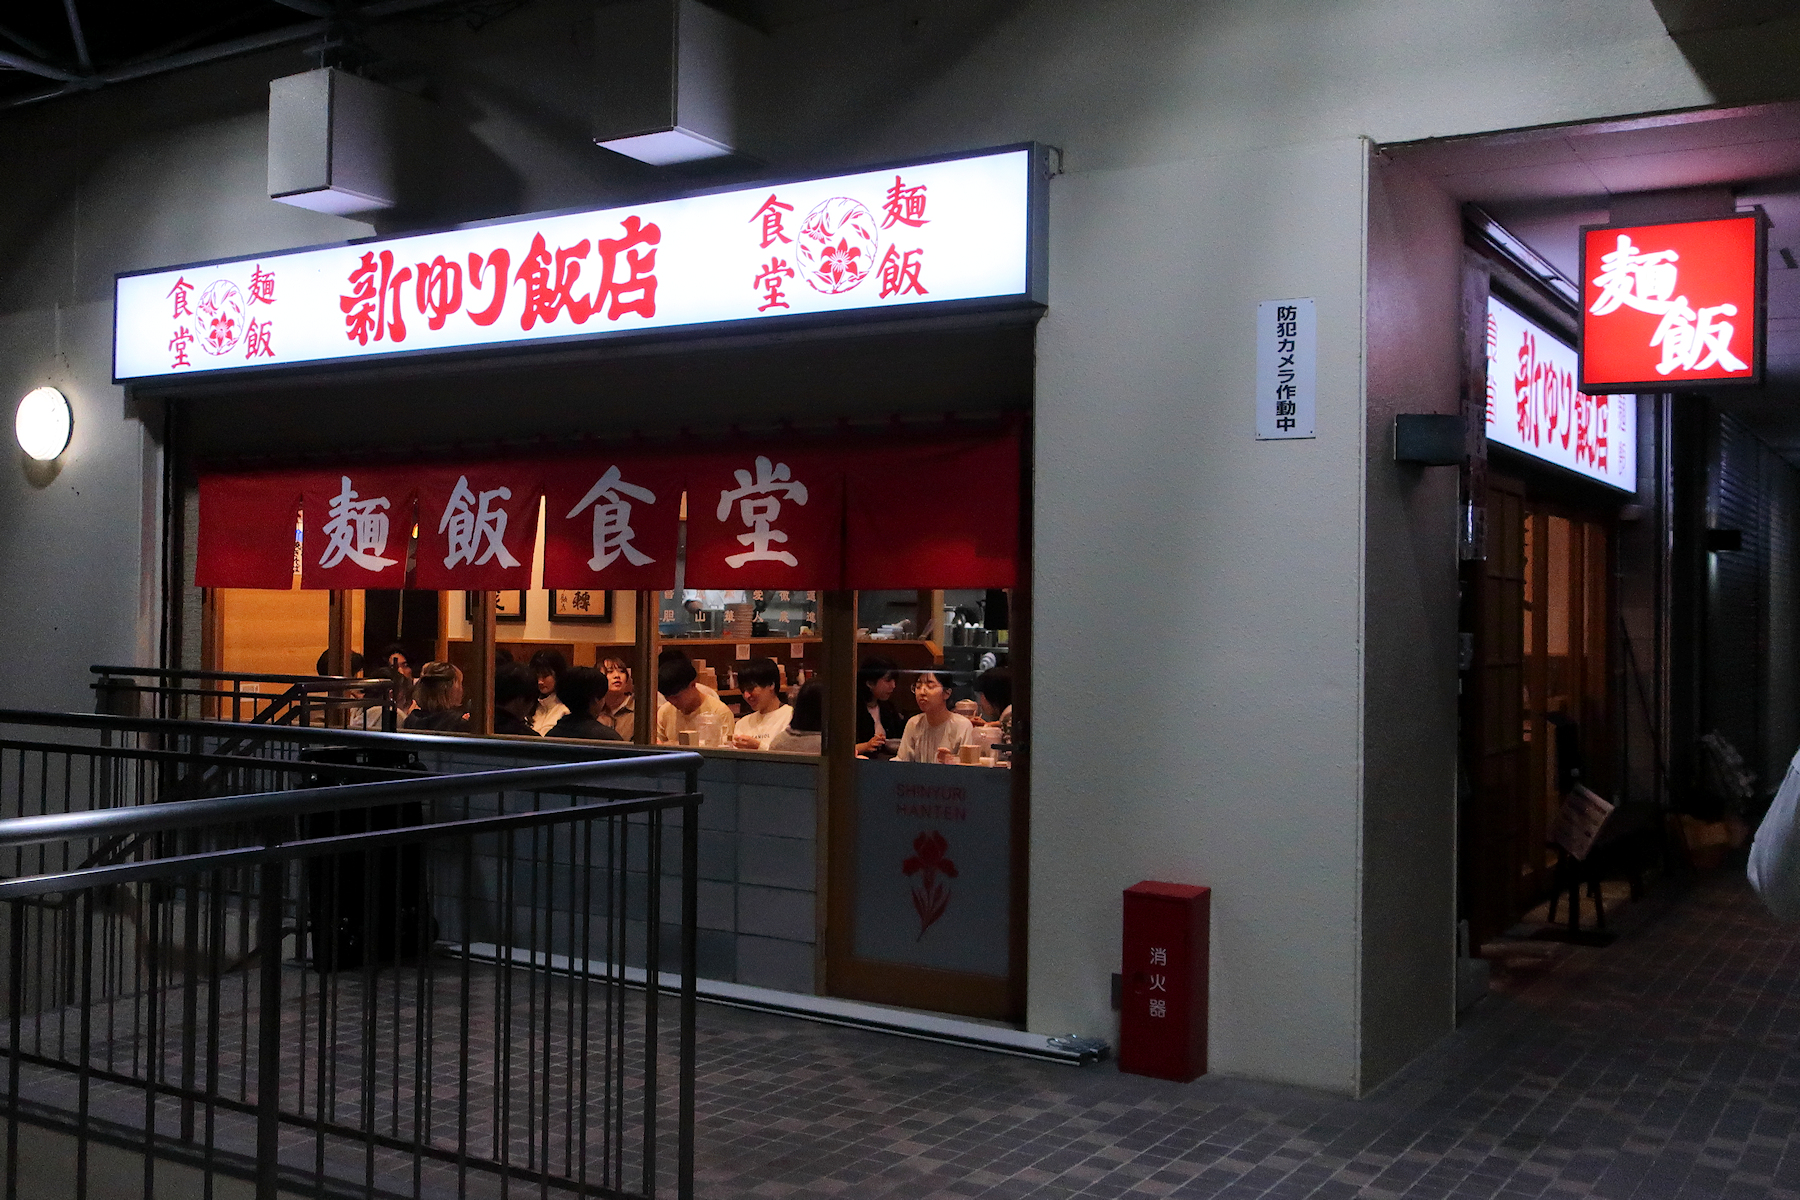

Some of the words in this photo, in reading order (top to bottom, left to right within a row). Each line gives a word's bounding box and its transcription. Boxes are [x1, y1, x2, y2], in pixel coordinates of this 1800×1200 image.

[340, 215, 662, 346] 新ゆり飯店
[748, 193, 795, 312] 食堂
[1589, 234, 1749, 375] 麺飯
[1276, 306, 1298, 432] 防犯カメラ作動中
[319, 455, 809, 572] 麺飯食堂
[895, 783, 967, 801] SHINYURI
[895, 803, 967, 821] HANTEN
[1150, 947, 1167, 1018] 消火器
